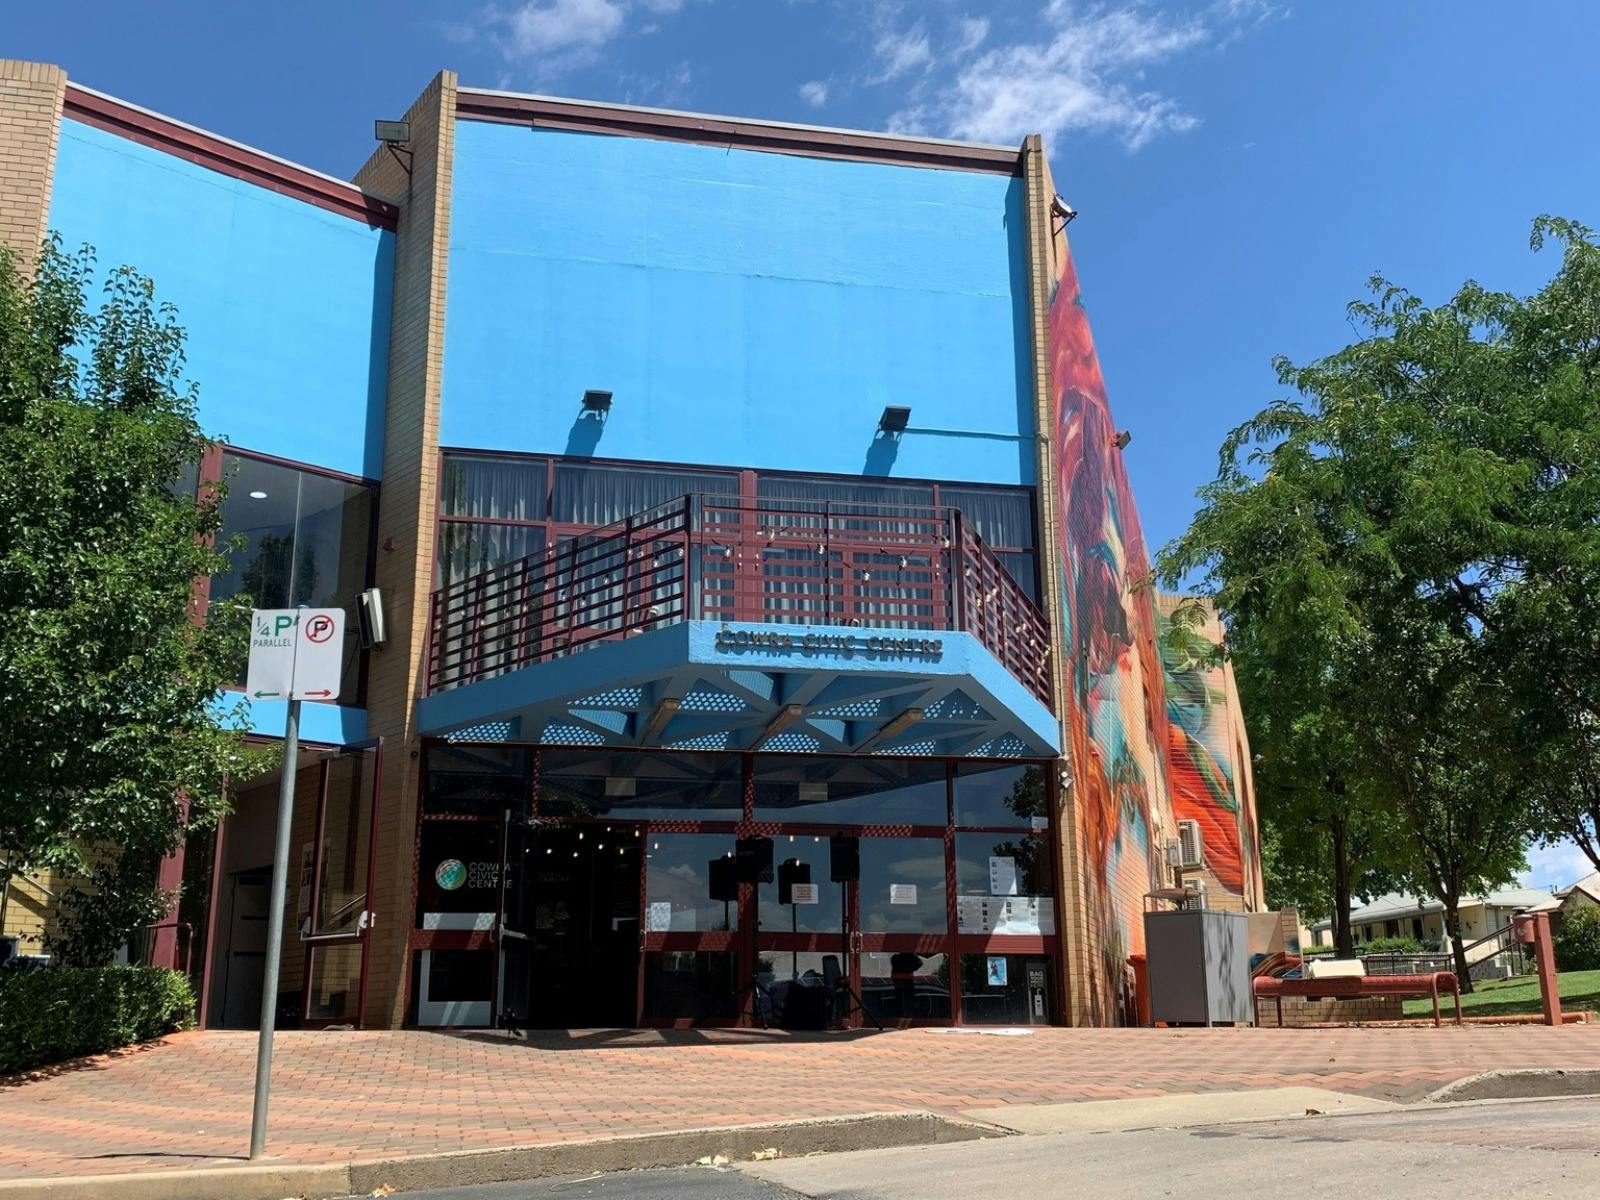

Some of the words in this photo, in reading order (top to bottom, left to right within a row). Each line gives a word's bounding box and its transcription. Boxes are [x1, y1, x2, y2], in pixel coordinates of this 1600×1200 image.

[253, 638, 292, 648] PARALLEL
[717, 630, 793, 647] COWRA
[803, 633, 856, 651] CIVIC
[867, 636, 943, 655] CENTRE
[469, 862, 512, 871] COWA
[469, 871, 499, 880] CIVIC
[468, 880, 513, 889] CENTE
